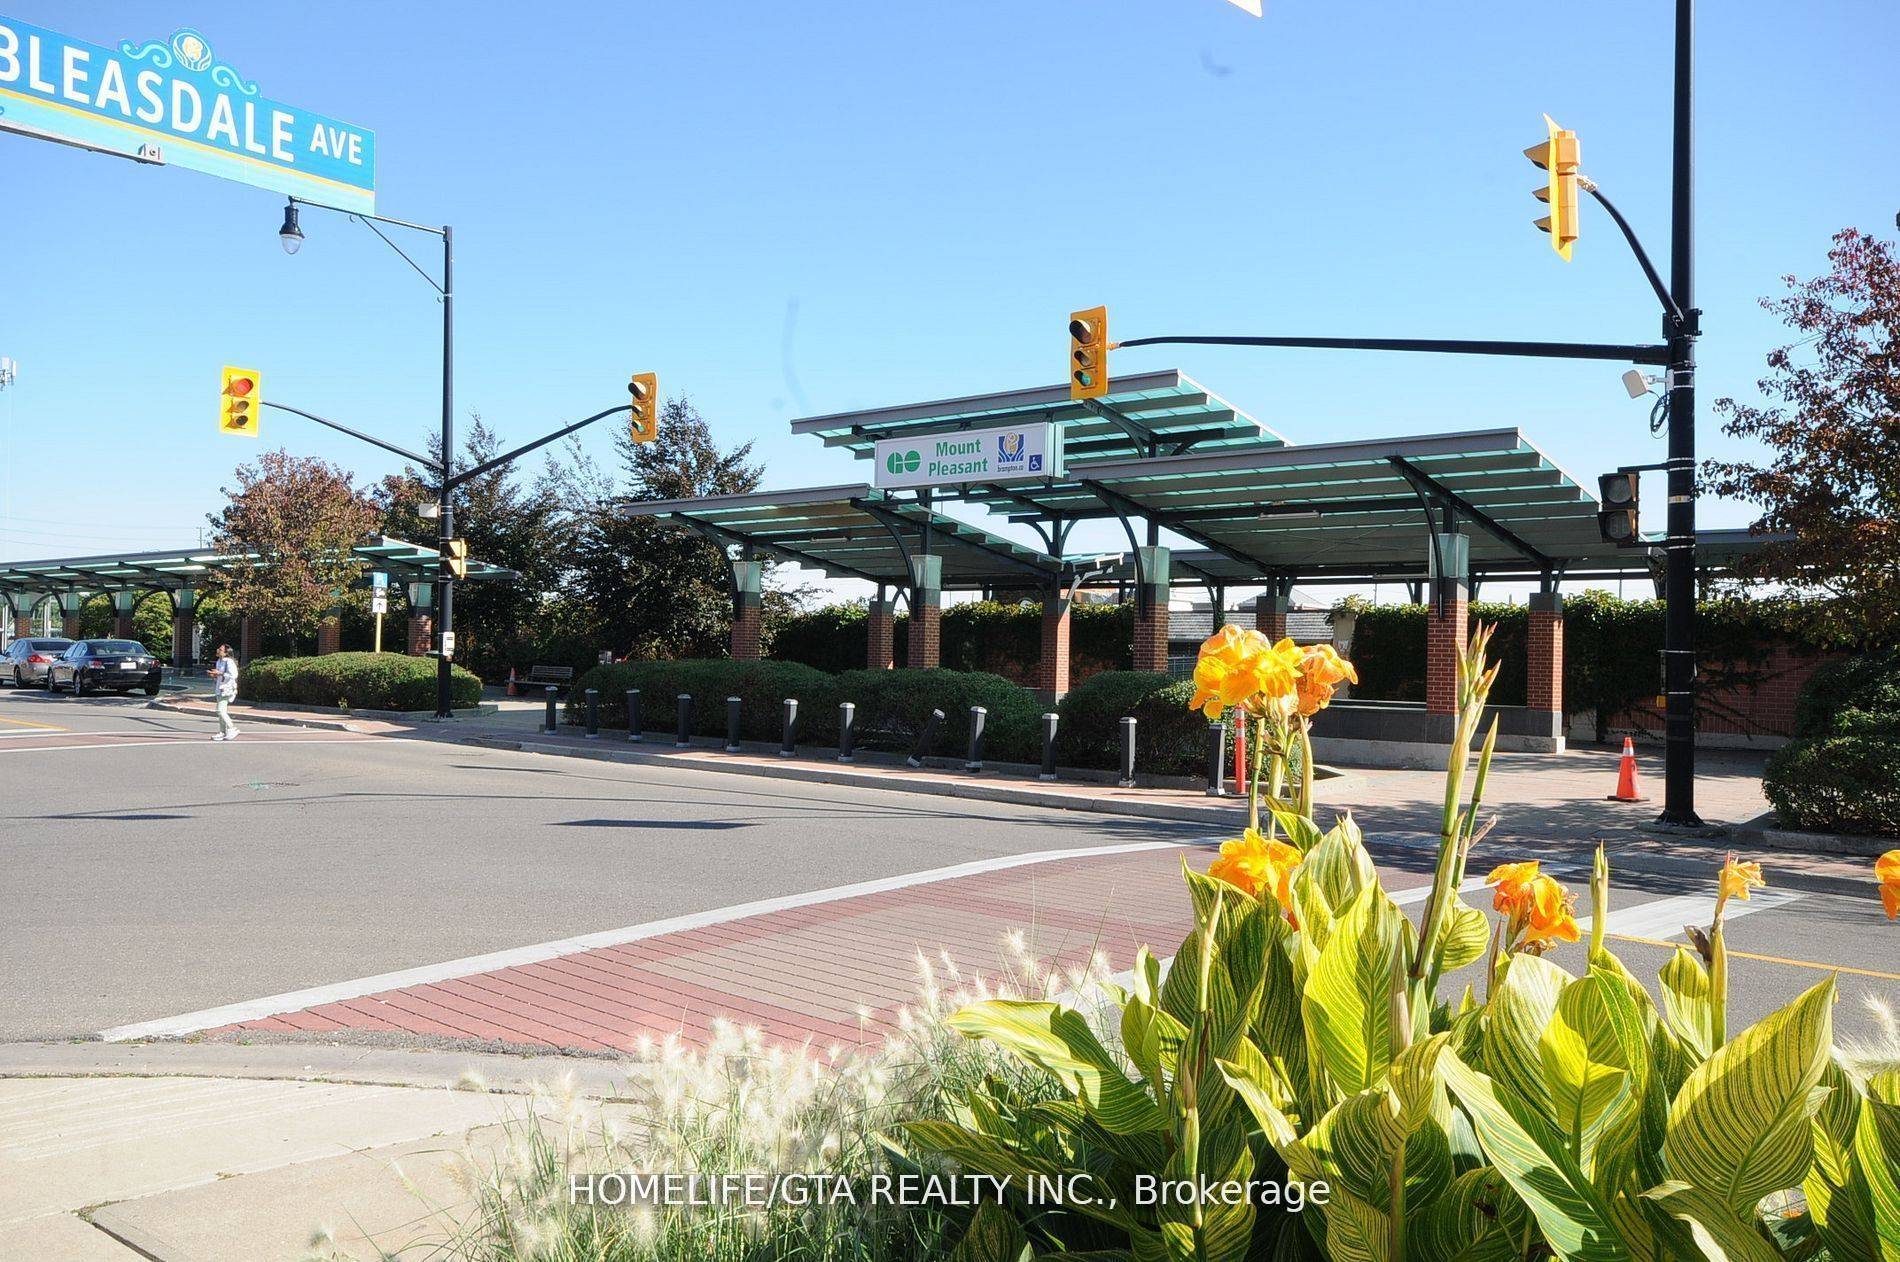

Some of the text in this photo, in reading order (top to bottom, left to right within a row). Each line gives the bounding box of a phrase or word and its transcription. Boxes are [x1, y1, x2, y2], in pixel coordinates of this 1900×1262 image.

[0, 25, 363, 166] BLEASDALE AVE
[936, 439, 982, 457] Mount
[929, 458, 988, 477] Pleasant
